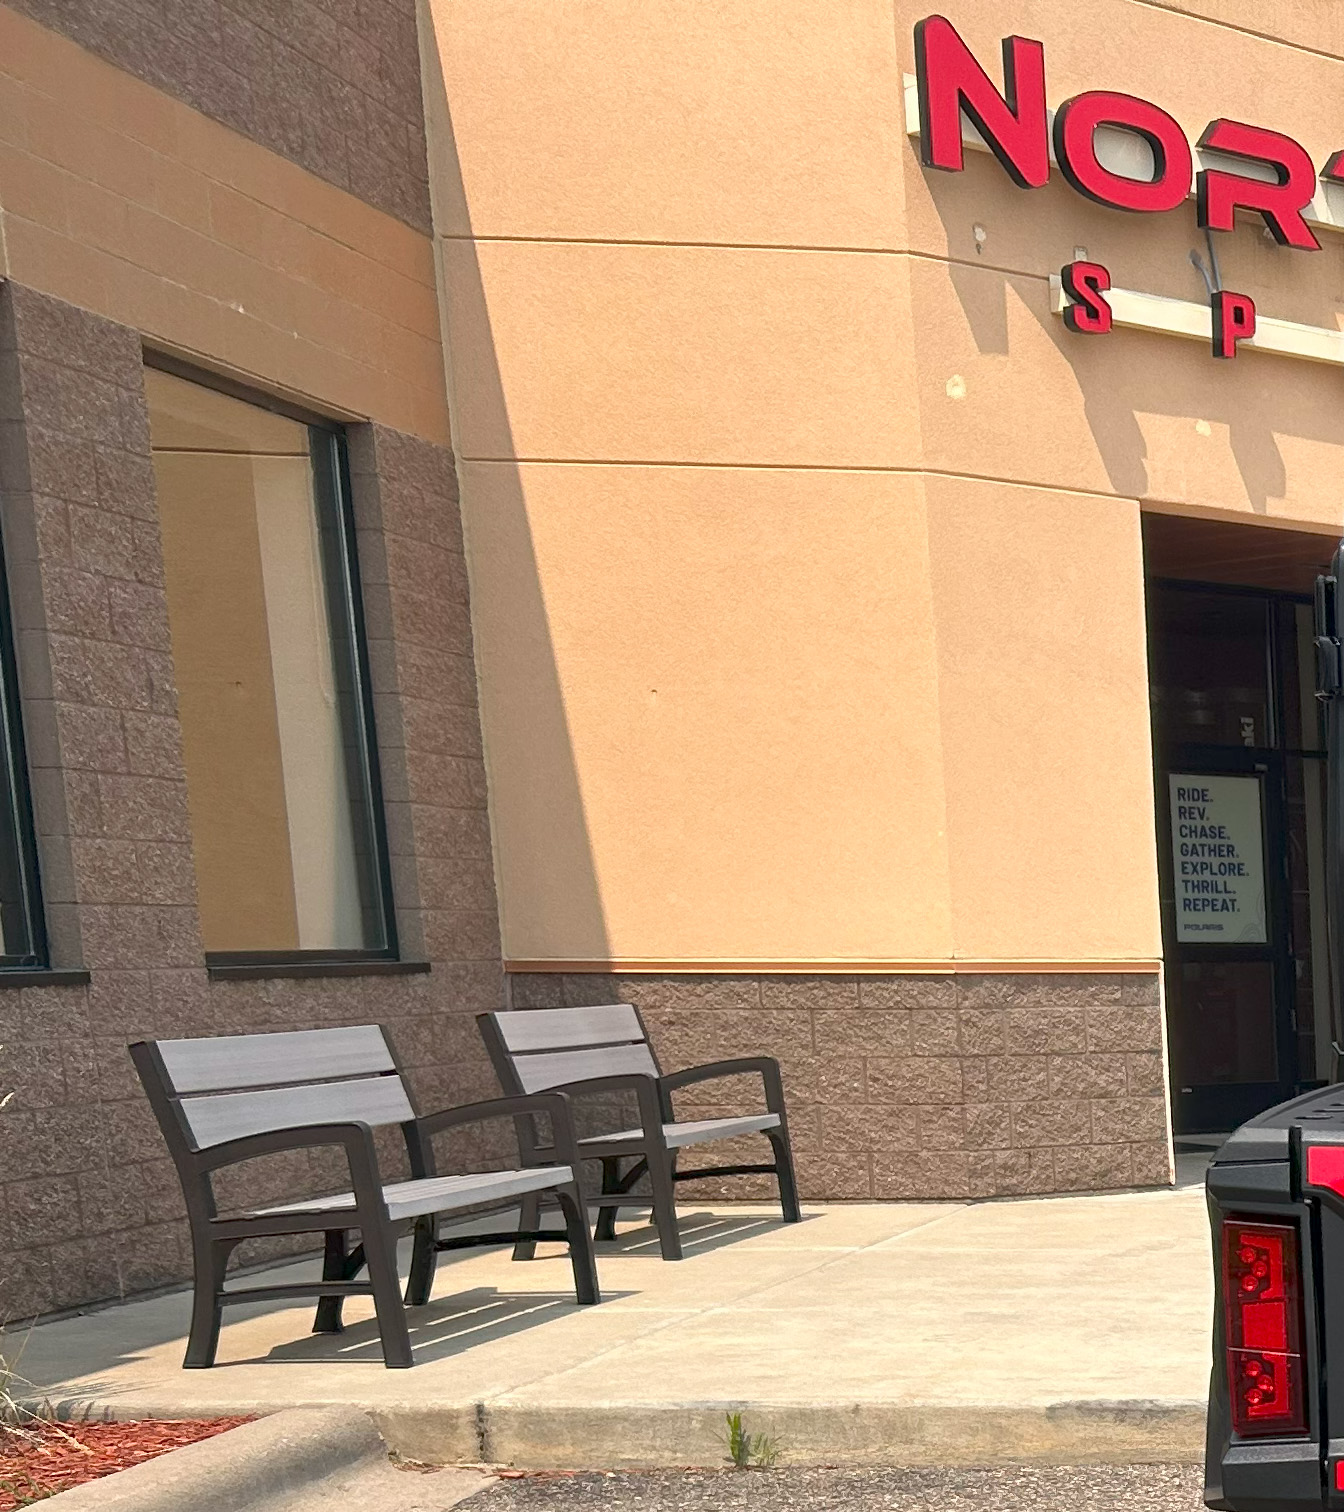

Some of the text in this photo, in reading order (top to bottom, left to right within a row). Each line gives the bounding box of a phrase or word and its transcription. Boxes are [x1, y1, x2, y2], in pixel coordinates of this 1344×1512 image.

[1177, 787, 1213, 802] RIDE.
[1178, 806, 1210, 821] REV.
[1179, 824, 1231, 840] CHASE.
[1180, 843, 1239, 858] GATHER.
[1181, 861, 1249, 876] EXPLORE.
[1182, 880, 1236, 894] THRILL.
[1183, 898, 1240, 912] REPEAT.
